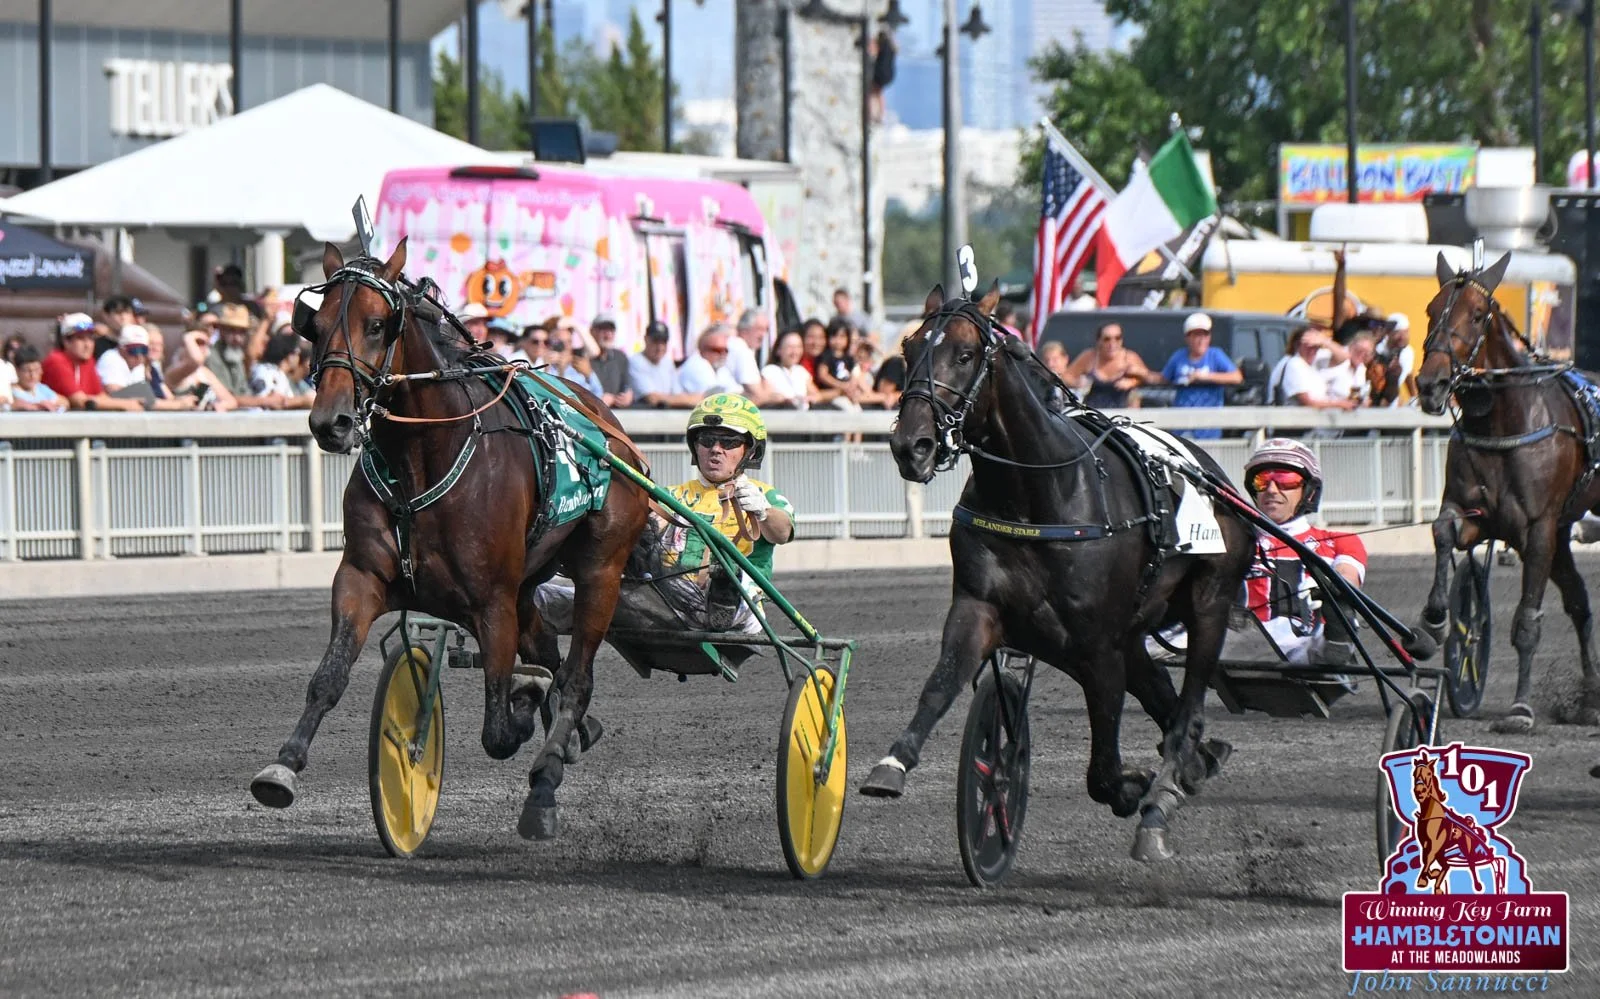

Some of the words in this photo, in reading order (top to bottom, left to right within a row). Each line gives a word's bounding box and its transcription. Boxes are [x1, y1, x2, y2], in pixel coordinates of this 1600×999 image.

[1288, 156, 1396, 194] BALLON
[1402, 155, 1470, 194] BUST
[359, 197, 373, 237] 4
[959, 245, 978, 292] 3
[1473, 238, 1484, 270] 10
[972, 517, 1012, 533] MELANDER
[1014, 527, 1041, 537] STABLE
